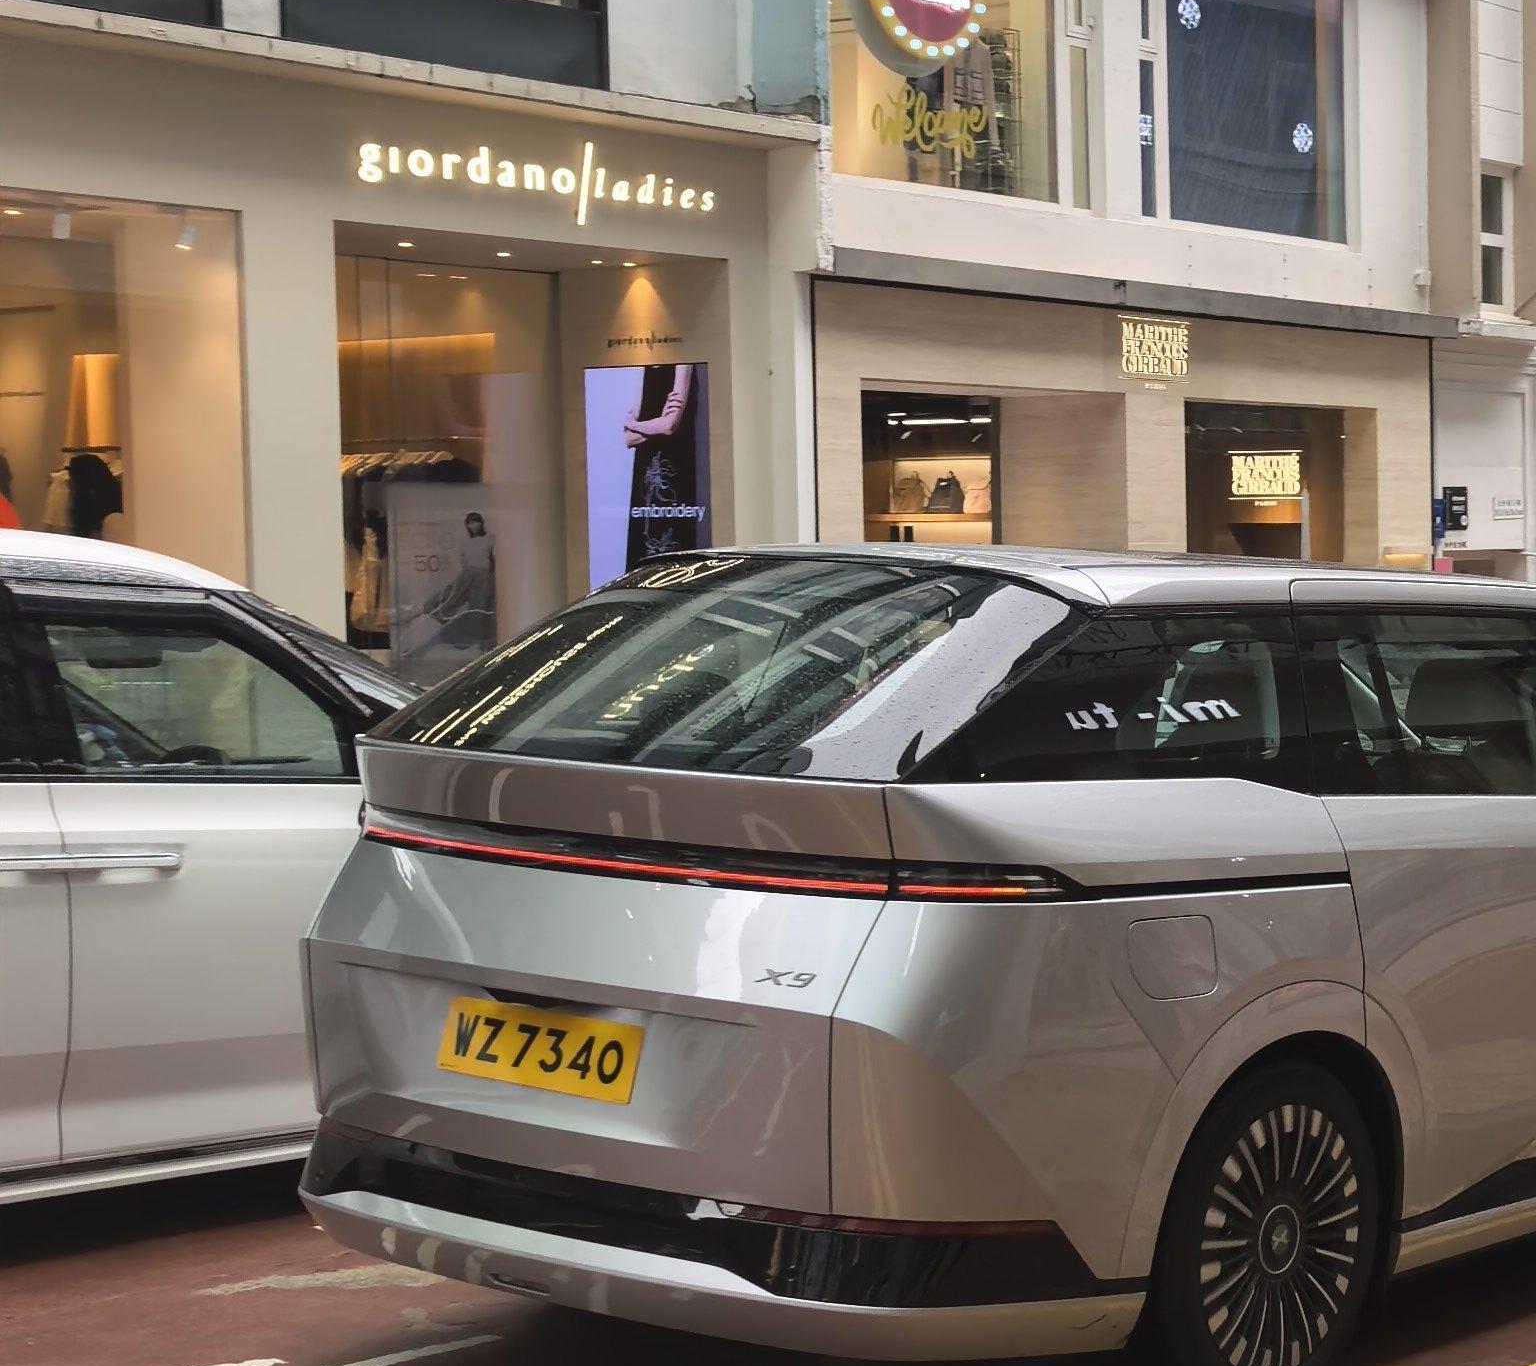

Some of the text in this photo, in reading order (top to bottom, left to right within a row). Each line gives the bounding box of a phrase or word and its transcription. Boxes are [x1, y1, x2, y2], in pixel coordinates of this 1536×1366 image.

[357, 142, 715, 211] giordano ladies
[631, 502, 706, 522] embroidery
[753, 968, 819, 988] X9
[454, 1011, 625, 1085] WZ 7340
